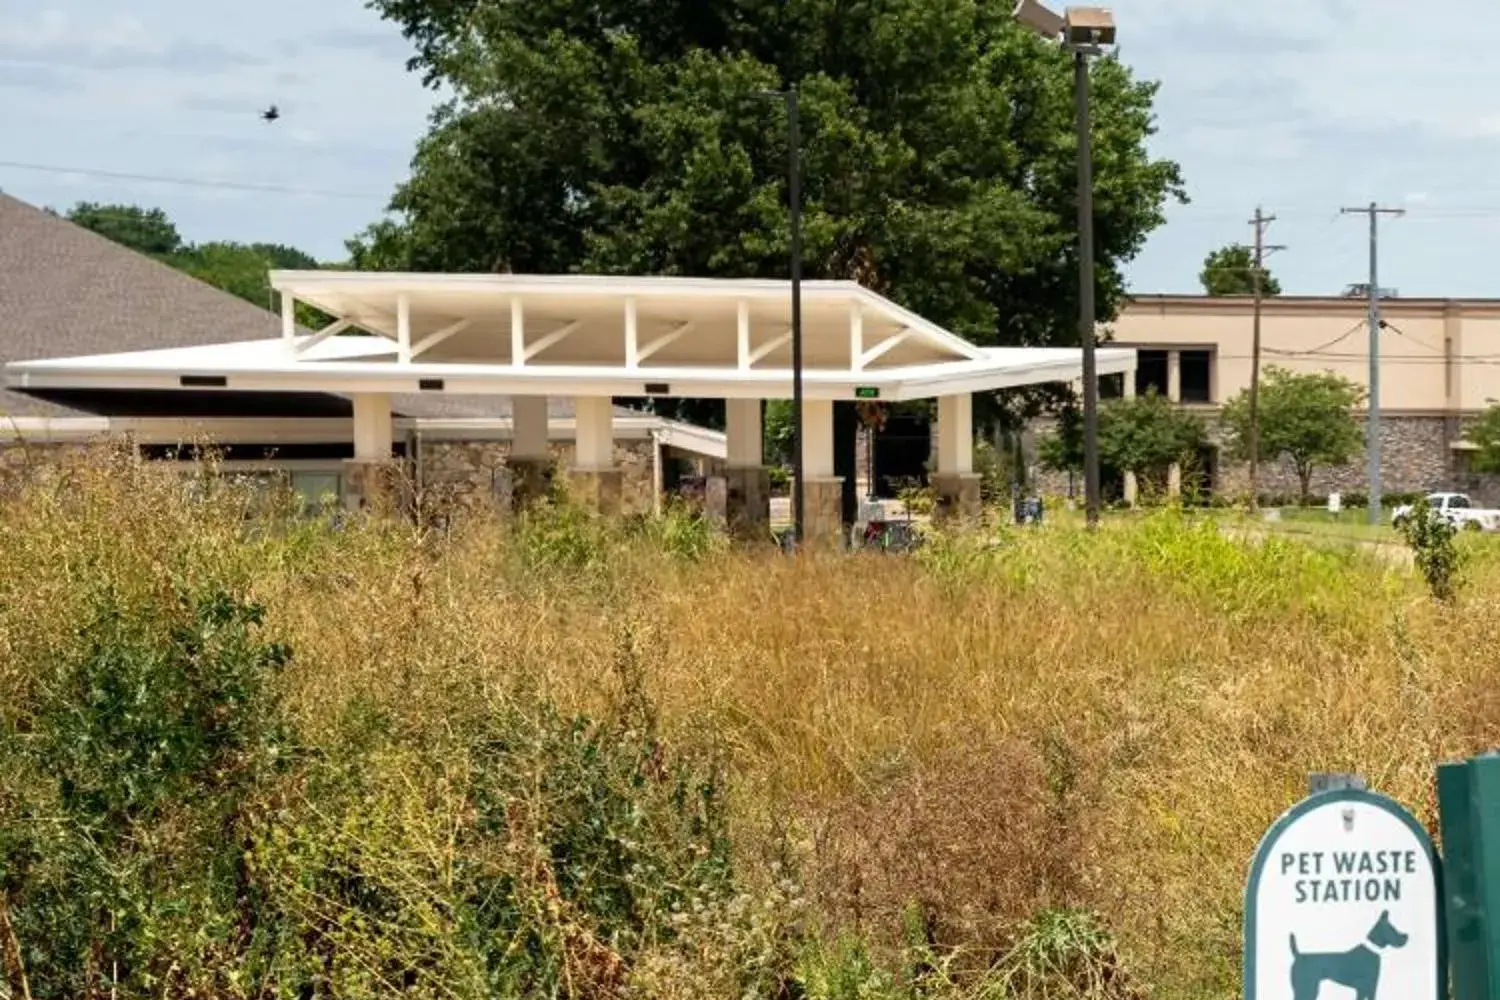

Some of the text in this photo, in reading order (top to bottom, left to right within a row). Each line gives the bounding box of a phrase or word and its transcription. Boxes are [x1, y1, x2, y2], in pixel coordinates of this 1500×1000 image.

[1281, 850, 1416, 875] PET WASTE
[1295, 878, 1401, 903] STATION
